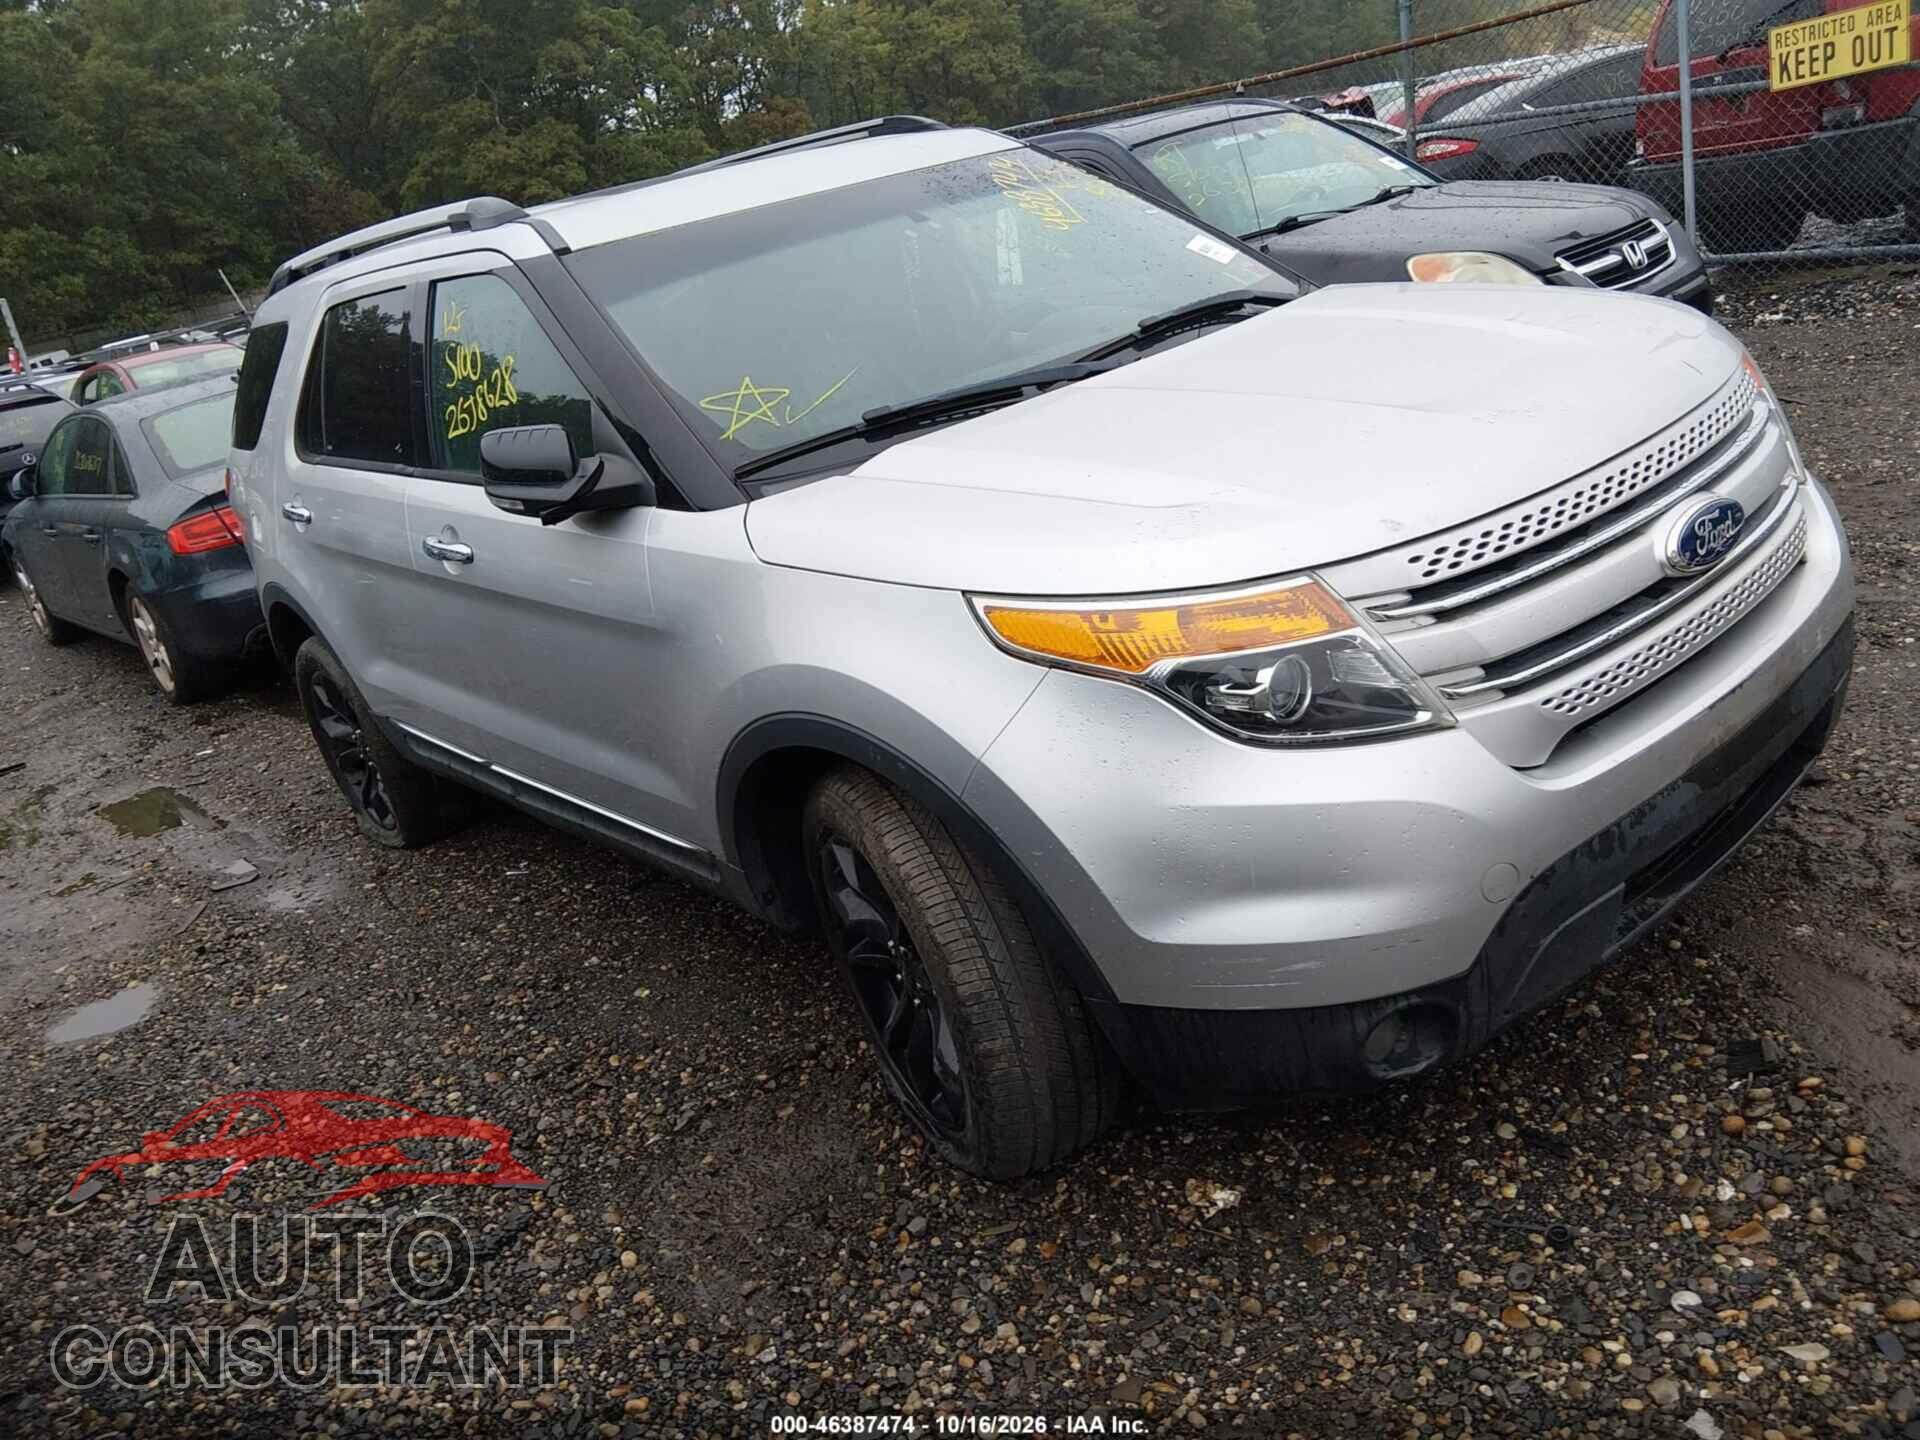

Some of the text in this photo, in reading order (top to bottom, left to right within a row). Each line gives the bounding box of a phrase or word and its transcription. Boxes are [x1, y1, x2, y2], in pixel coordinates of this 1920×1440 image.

[1775, 15, 1855, 50] RESTRICTED
[1866, 3, 1902, 28] AREA
[1778, 40, 1836, 83] KEEP
[1852, 26, 1898, 67] OUT
[1694, 508, 1739, 556] Ford
